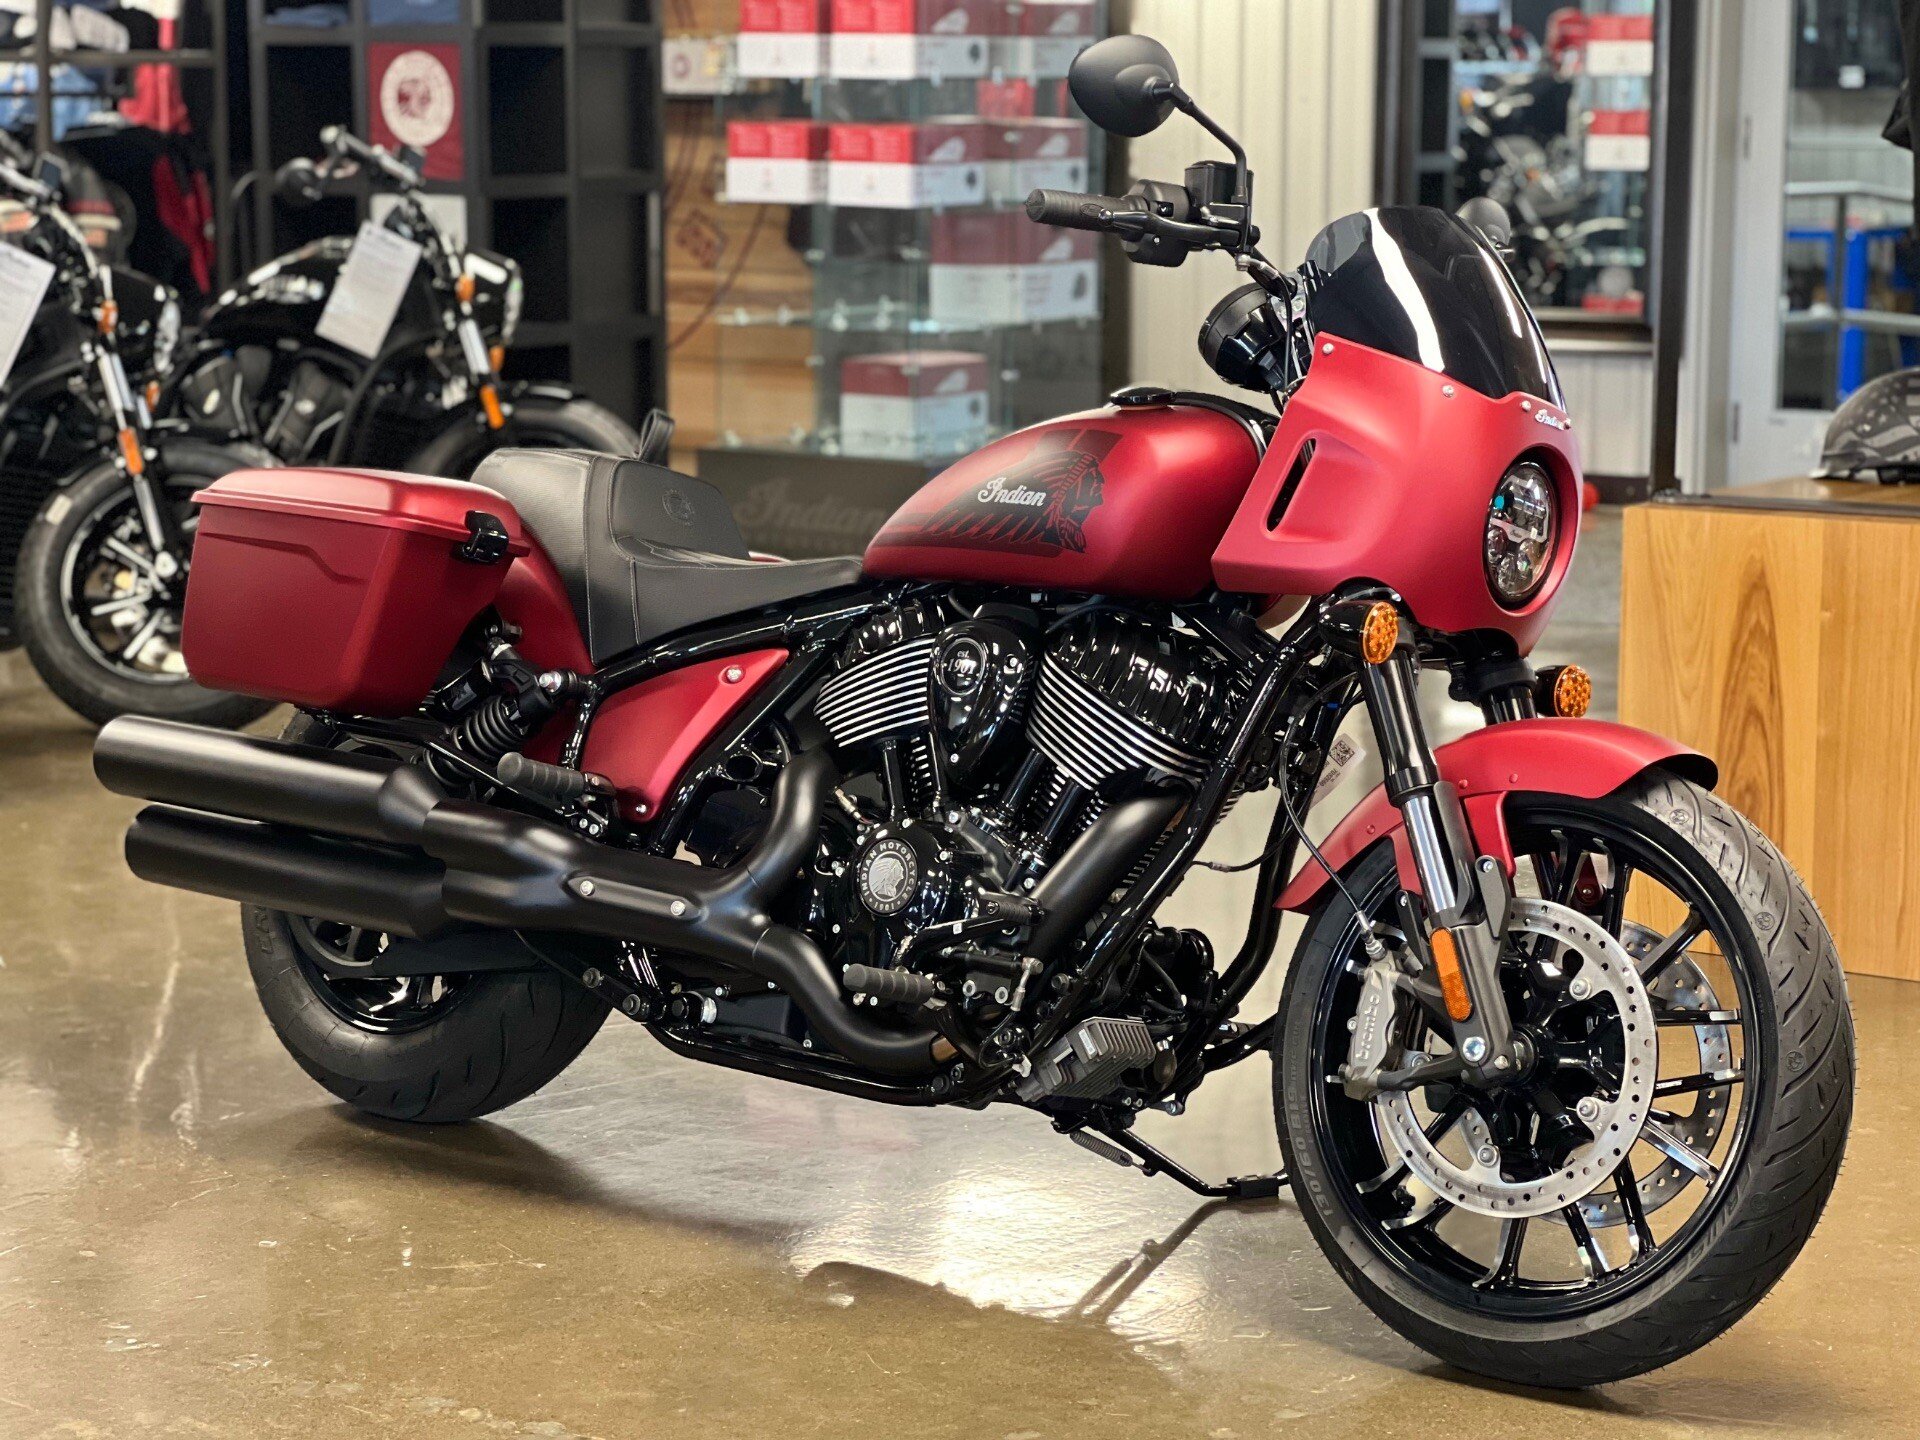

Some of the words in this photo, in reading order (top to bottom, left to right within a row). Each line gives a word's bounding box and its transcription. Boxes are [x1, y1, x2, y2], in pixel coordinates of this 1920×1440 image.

[977, 477, 1047, 507] Indian
[861, 849, 878, 897] INDIAN
[879, 841, 917, 900] MOTORCYCLE
[1354, 994, 1381, 1061] brembo
